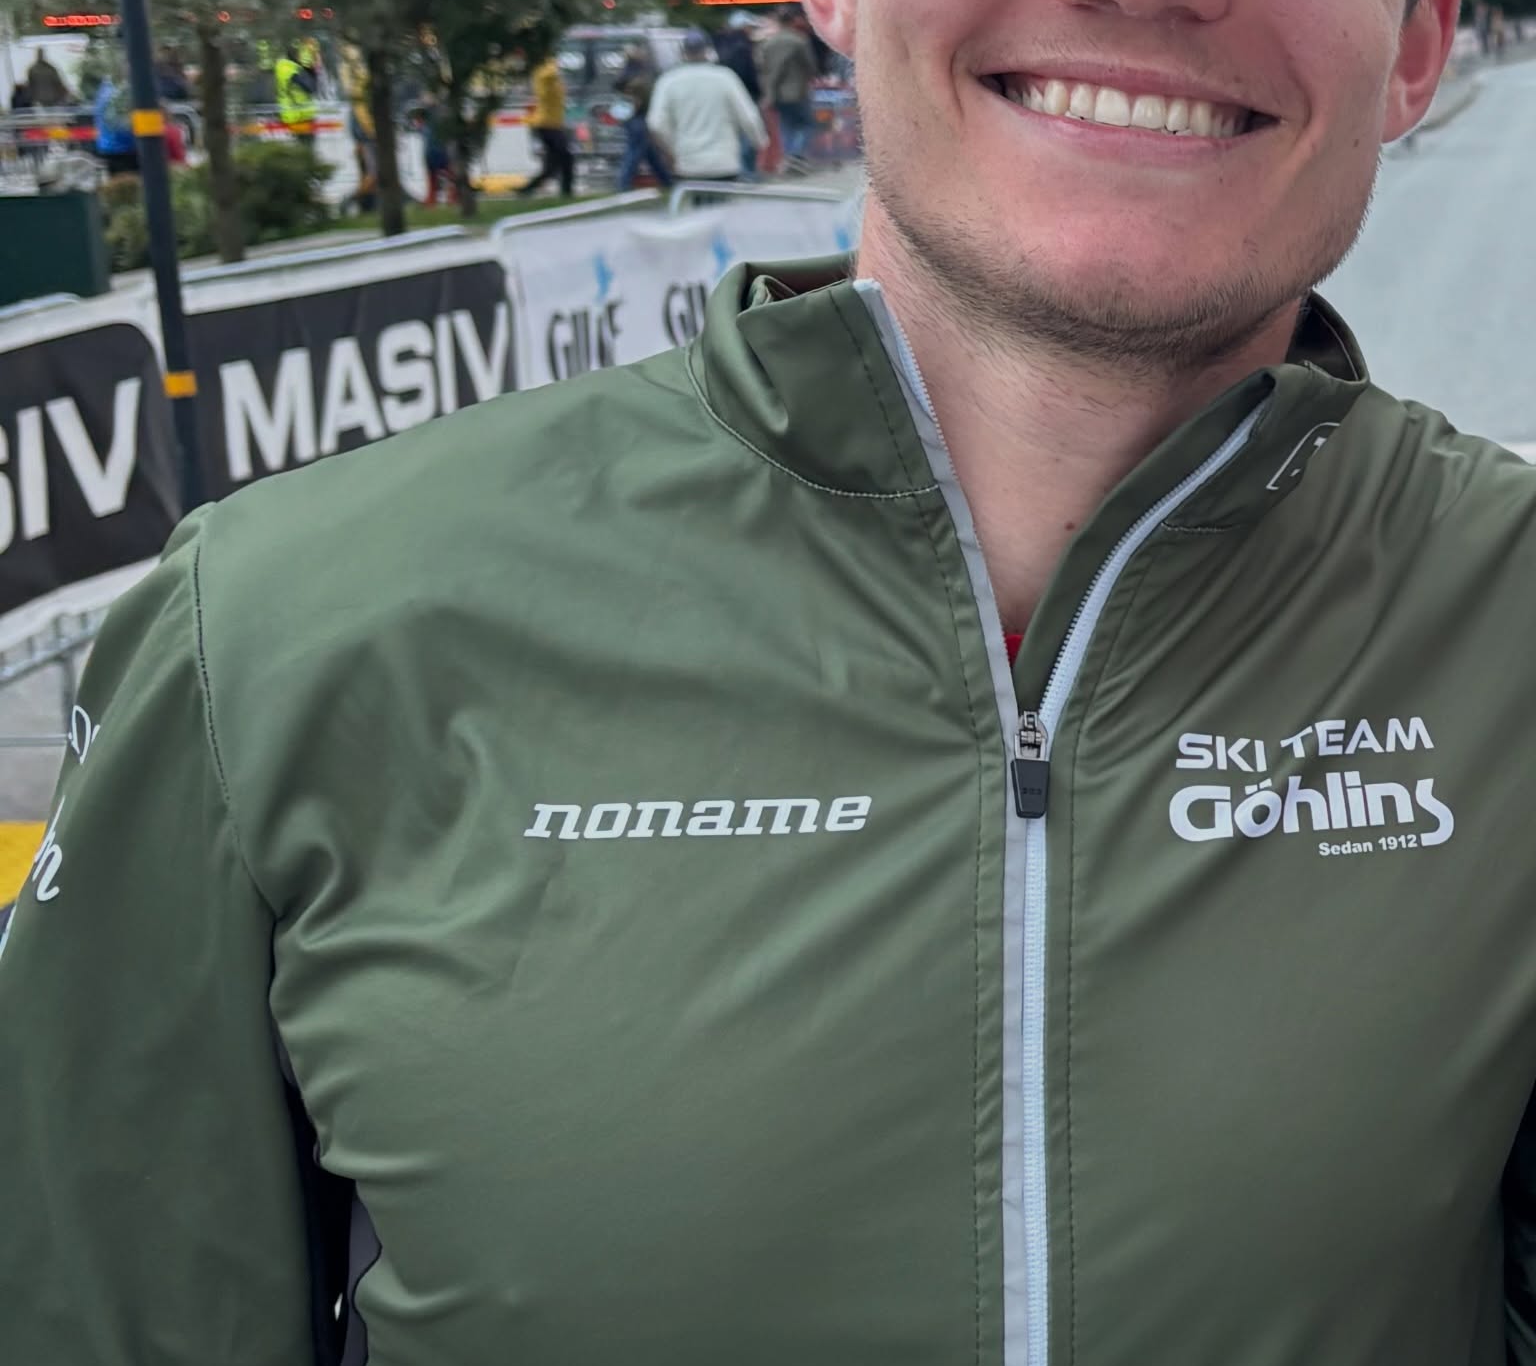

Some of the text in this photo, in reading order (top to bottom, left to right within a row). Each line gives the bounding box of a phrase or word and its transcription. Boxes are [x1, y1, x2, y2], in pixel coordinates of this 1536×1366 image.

[218, 301, 511, 483] MASIV
[1175, 716, 1435, 773] SKI TEAM
[523, 795, 872, 840] noname
[1168, 770, 1455, 848] Göhlins
[1318, 834, 1419, 856] Sedan 1912
